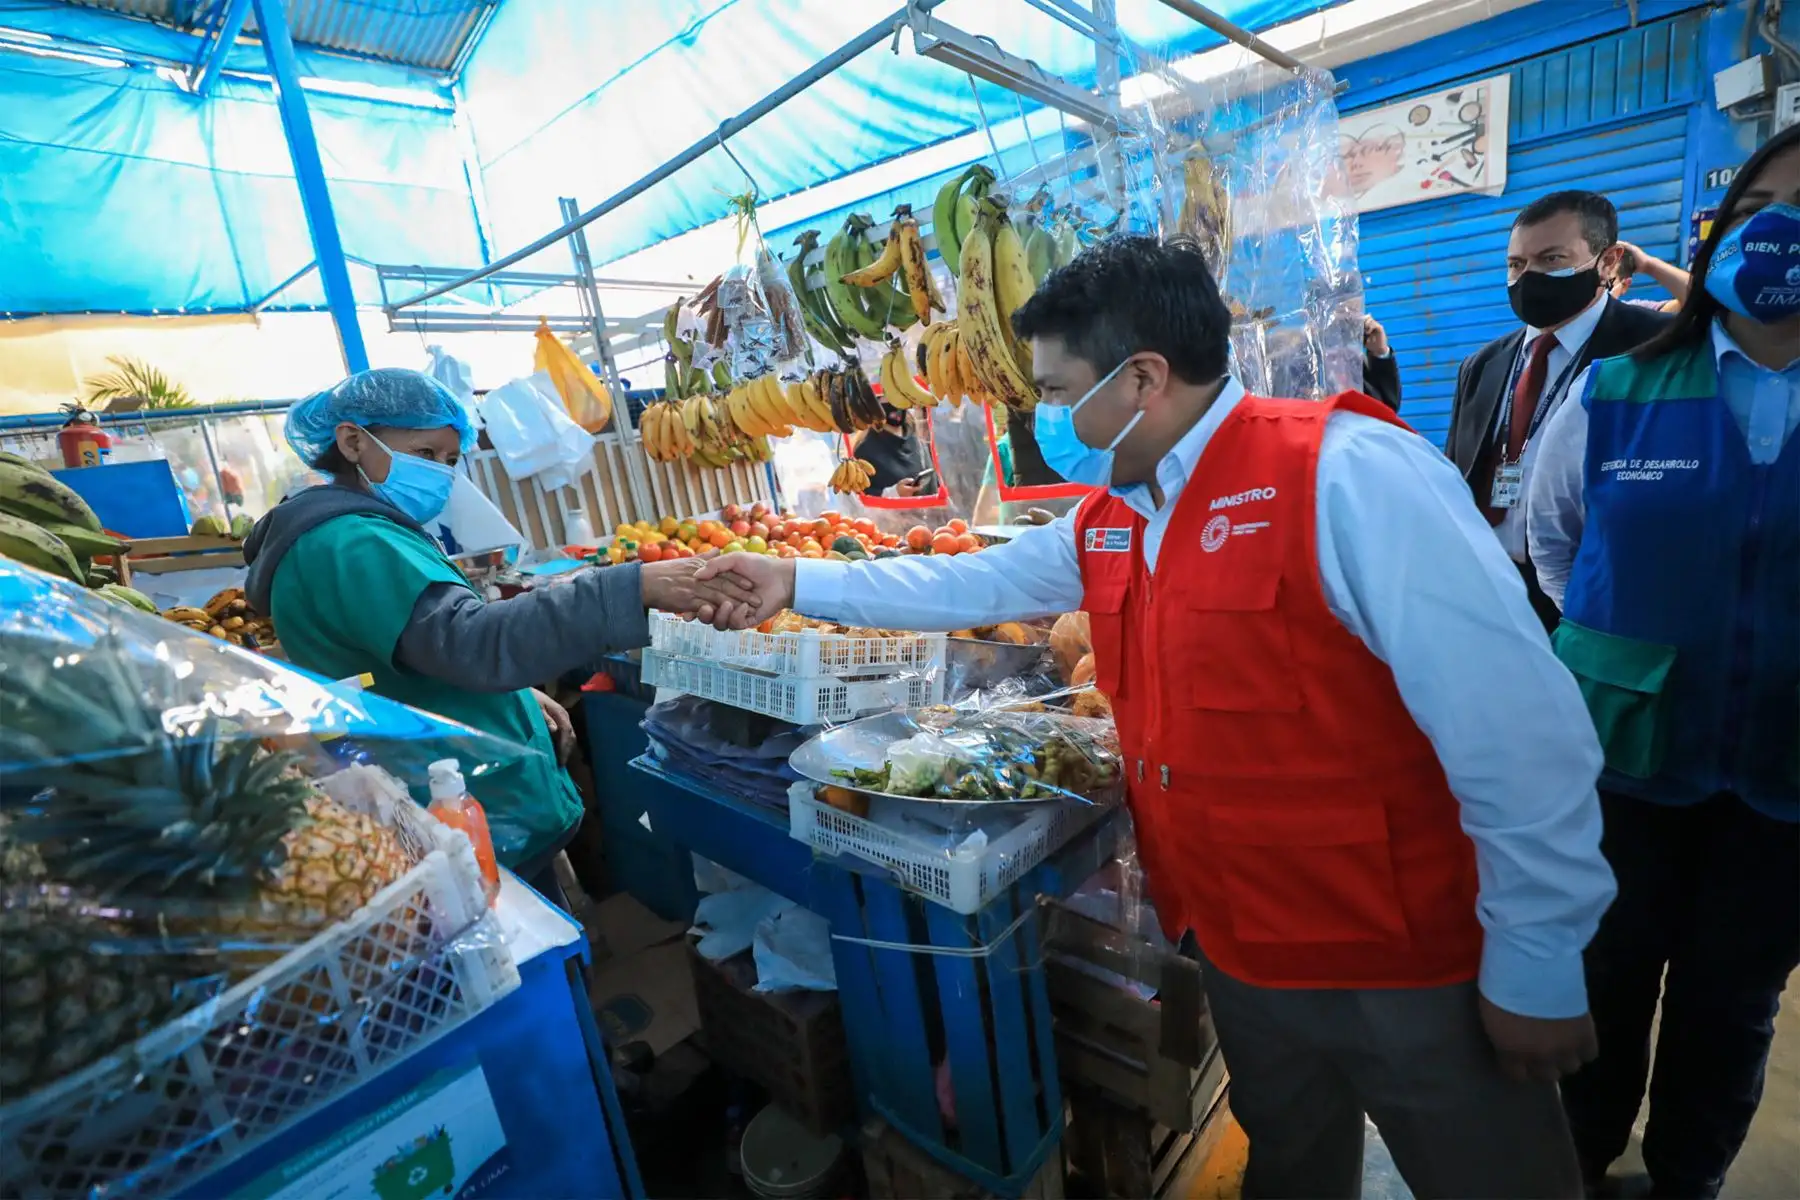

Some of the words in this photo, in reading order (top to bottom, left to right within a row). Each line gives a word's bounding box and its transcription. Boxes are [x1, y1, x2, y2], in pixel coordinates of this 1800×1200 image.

[1745, 242, 1782, 256] BIEN,
[1788, 243, 1800, 255] P
[1629, 459, 1643, 469] DE
[1643, 459, 1699, 469] DESARROLLO
[1209, 487, 1277, 511] MINISTRO
